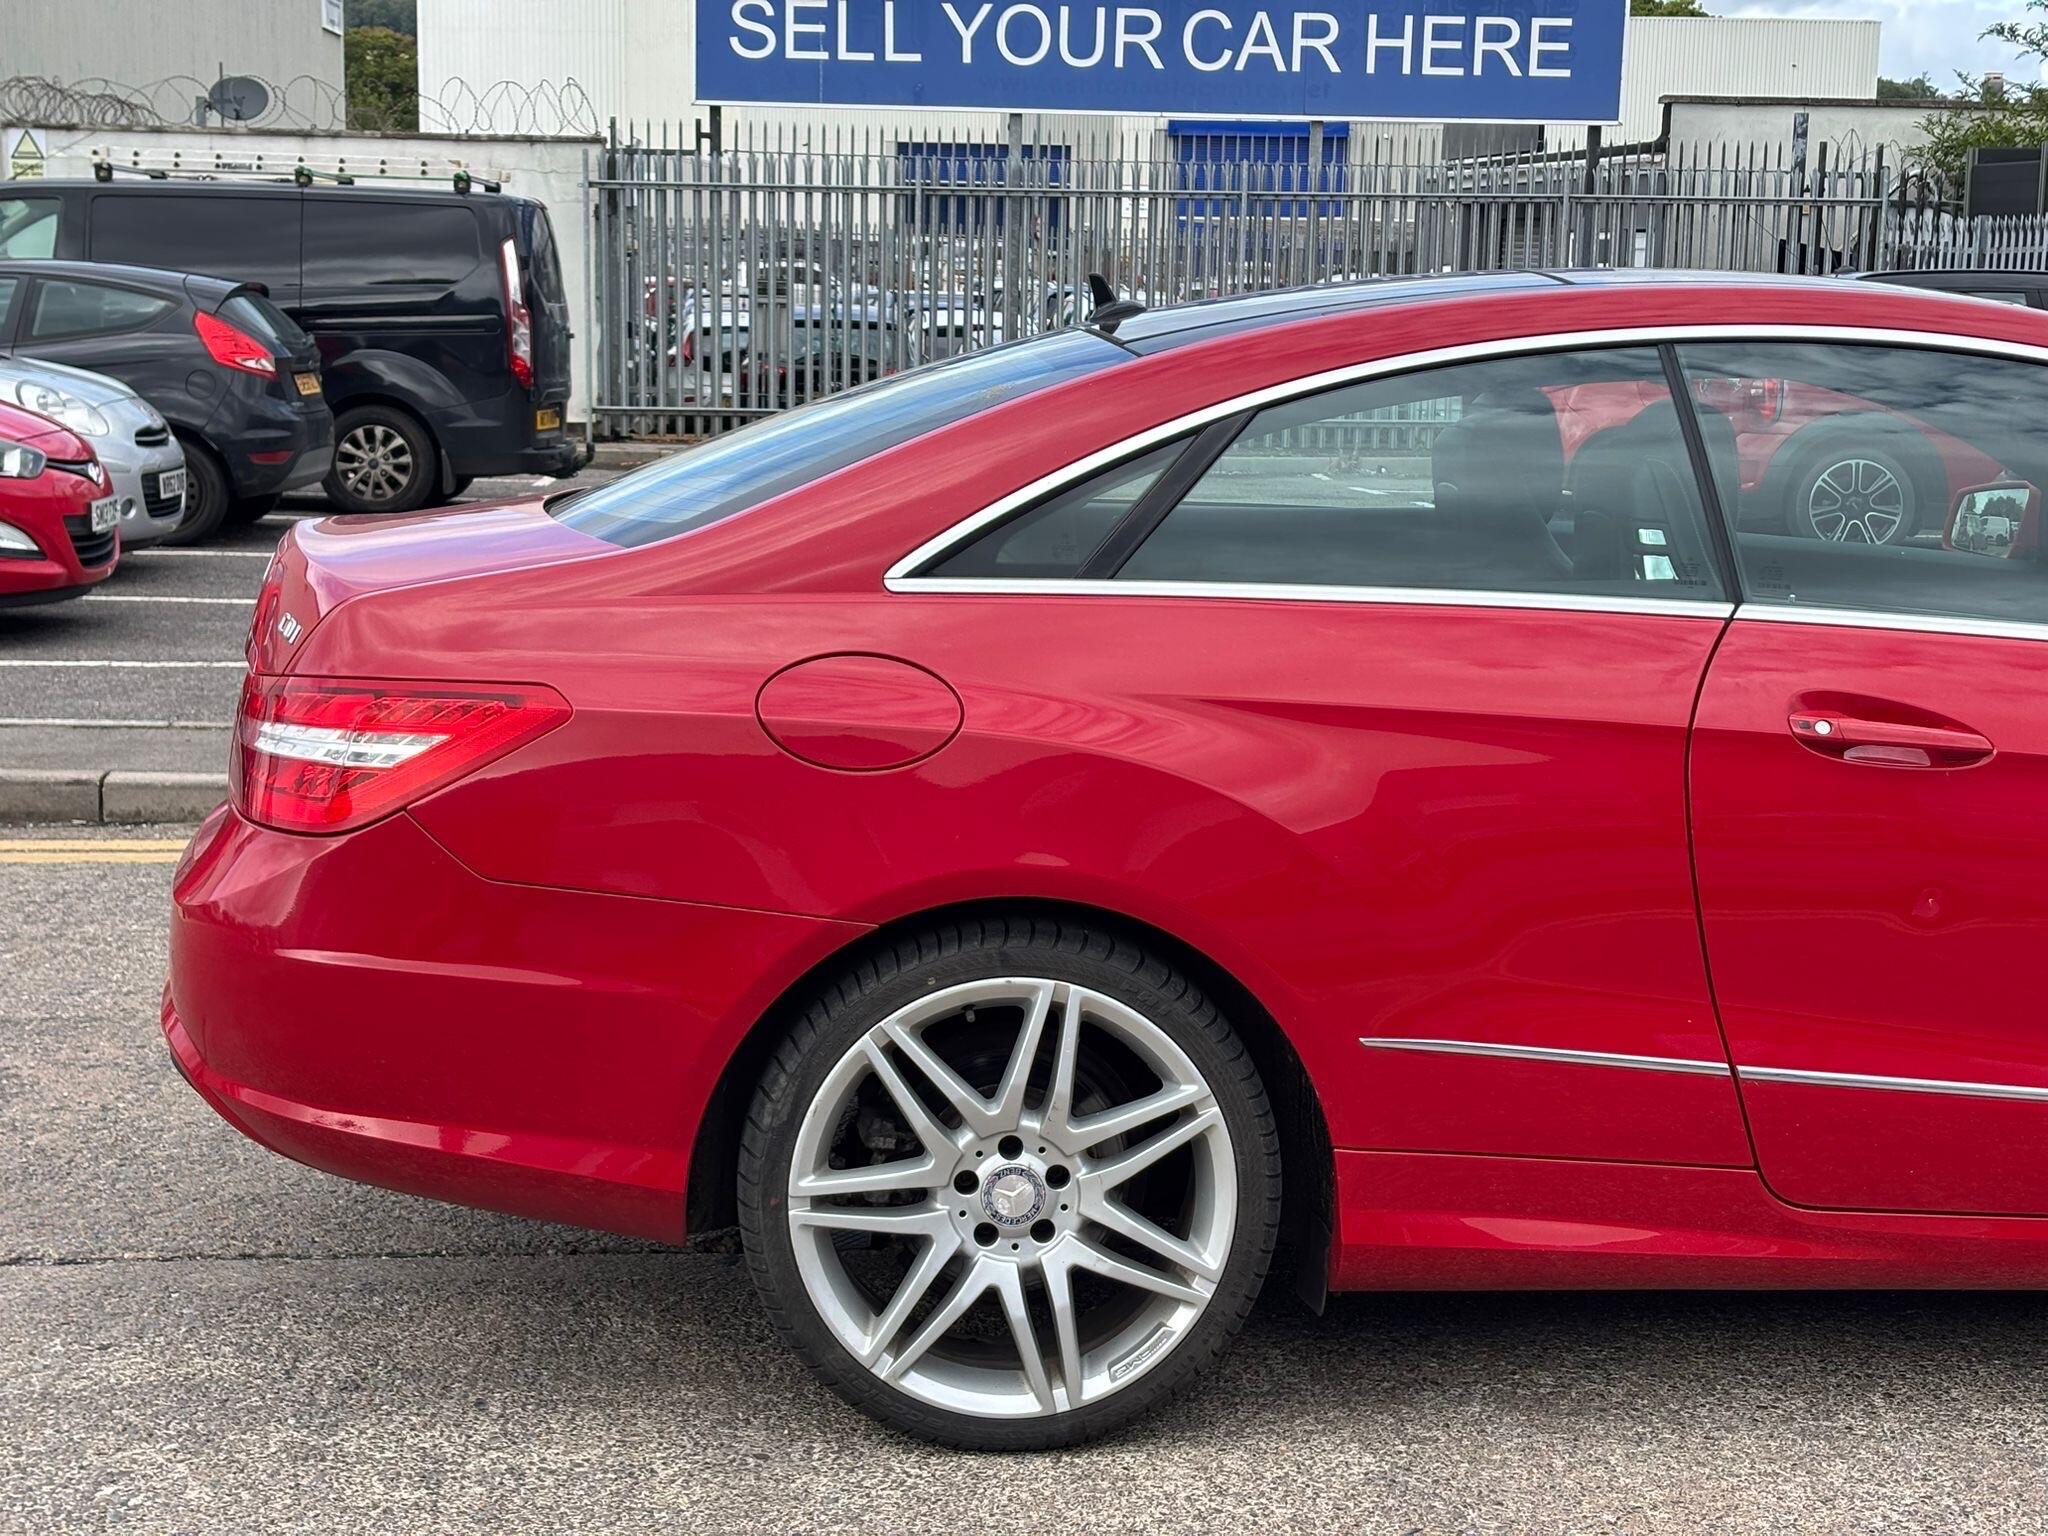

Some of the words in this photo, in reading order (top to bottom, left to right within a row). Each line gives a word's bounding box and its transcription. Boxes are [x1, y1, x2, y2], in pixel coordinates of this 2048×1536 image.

[729, 0, 922, 61] SELL
[942, 3, 1165, 68] YOUR
[1183, 10, 1342, 73] CAR
[1366, 14, 1573, 77] HERE
[278, 612, 302, 644] CDI
[998, 1168, 1022, 1177] BENZ
[994, 1205, 1038, 1225] MERCEDES
[1114, 1337, 1160, 1379] AMG
